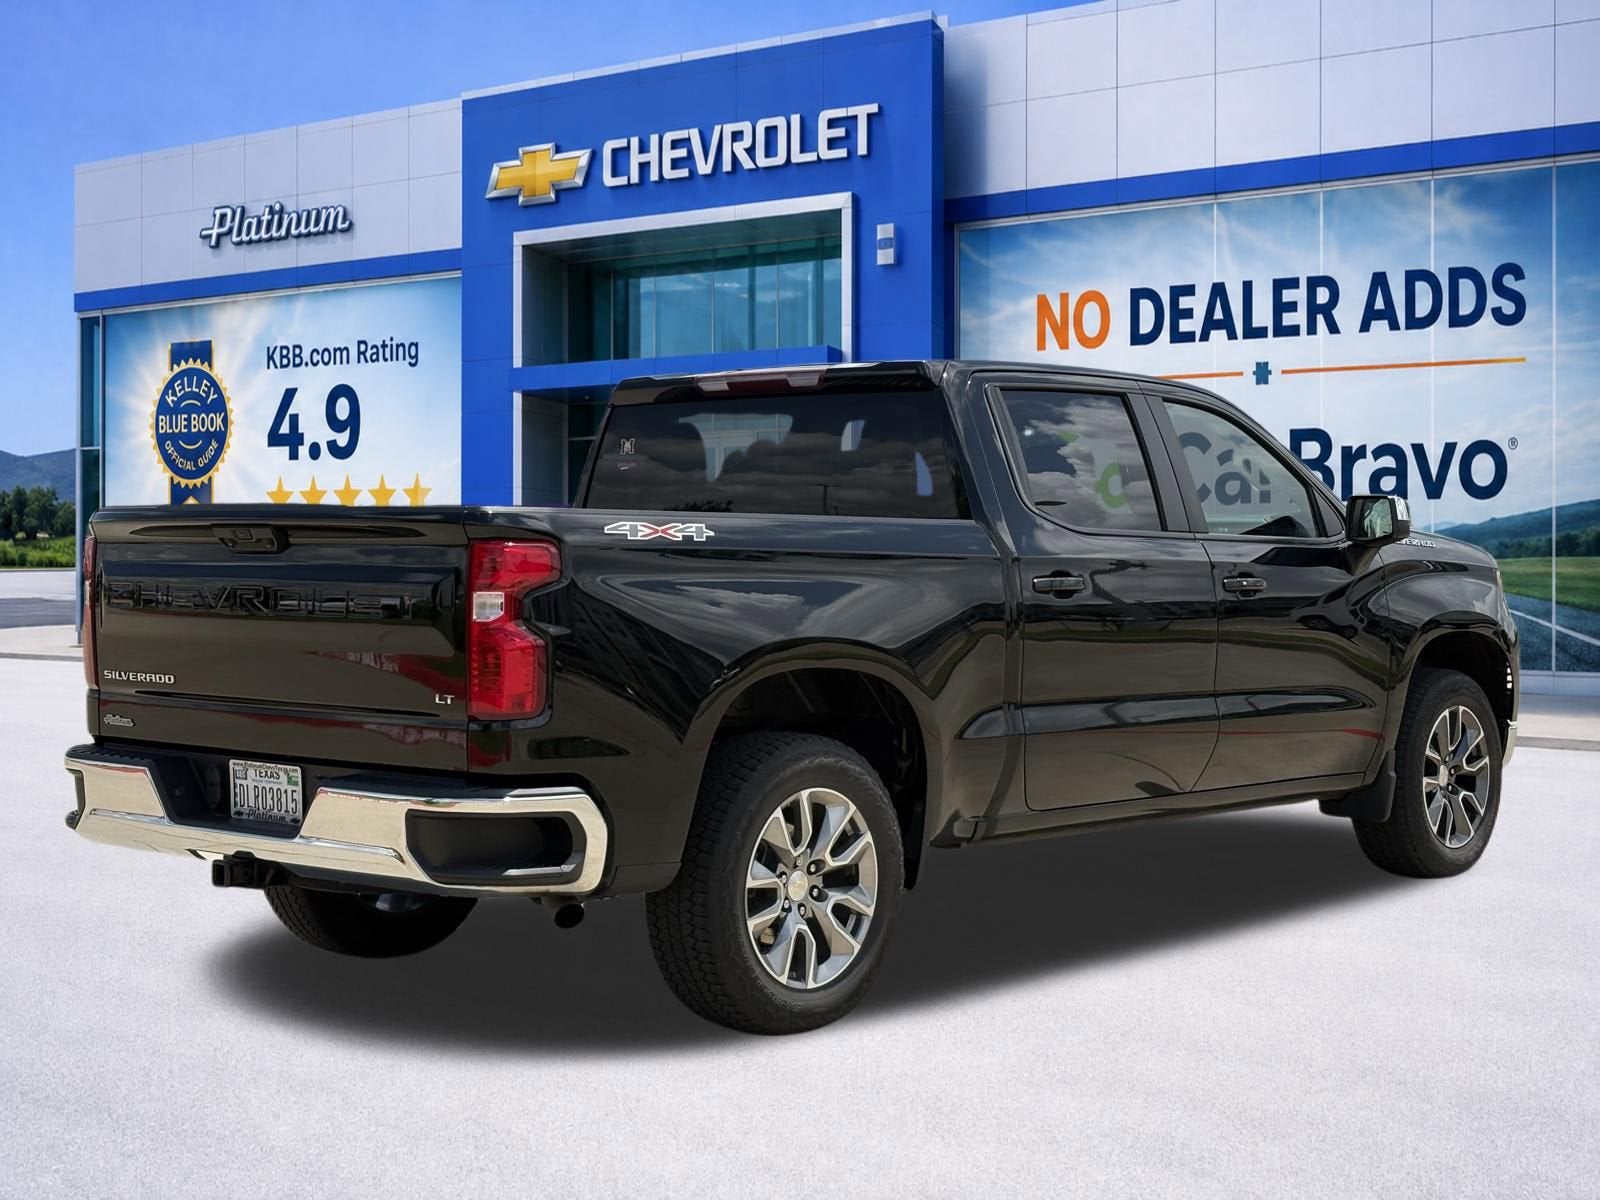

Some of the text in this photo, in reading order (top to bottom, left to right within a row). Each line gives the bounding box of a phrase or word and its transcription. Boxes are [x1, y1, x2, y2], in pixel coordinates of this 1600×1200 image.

[602, 103, 879, 187] CHEVROLET
[200, 201, 351, 247] Platinum
[1036, 261, 1526, 351] NO DEALER ADDS
[266, 337, 419, 369] KBB.com Rating
[165, 375, 218, 407] KELLEY
[159, 412, 225, 433] BLUE BOOK
[267, 383, 361, 461] 4.9
[164, 440, 196, 470] OFFICIAL
[104, 670, 175, 684] SILVERADO
[435, 693, 455, 704] LT
[253, 769, 281, 780] TEXAS
